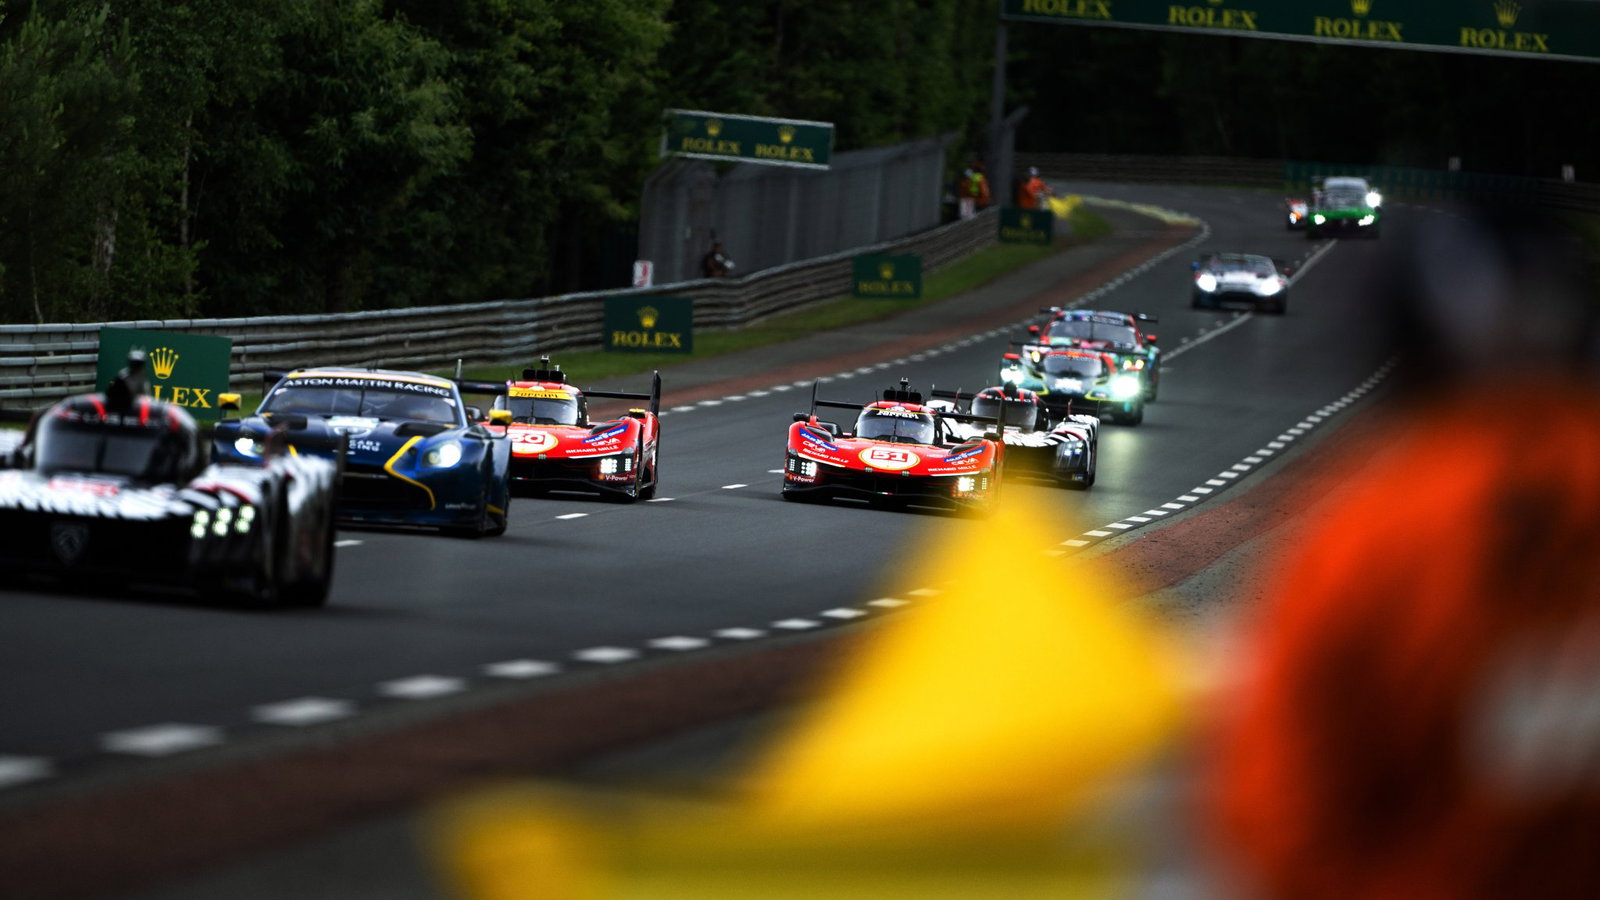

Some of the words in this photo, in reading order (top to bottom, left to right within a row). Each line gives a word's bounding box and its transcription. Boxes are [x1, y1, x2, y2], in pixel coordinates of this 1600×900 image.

[1022, 0, 1112, 19] ROLEX
[1168, 5, 1258, 30] ROLEX
[1314, 16, 1404, 41] ROLEX
[1460, 27, 1549, 51] ROLEX
[682, 137, 740, 155] ROLEX
[755, 144, 814, 162] ROLEX
[612, 330, 682, 348] ROLEX
[153, 385, 212, 408] LEX
[284, 378, 334, 386] ASTON
[336, 379, 391, 388] MARTIN
[394, 381, 450, 397] RACING
[876, 410, 919, 419] Ferrari
[872, 449, 908, 462] 51
[792, 475, 816, 483] V-Power
